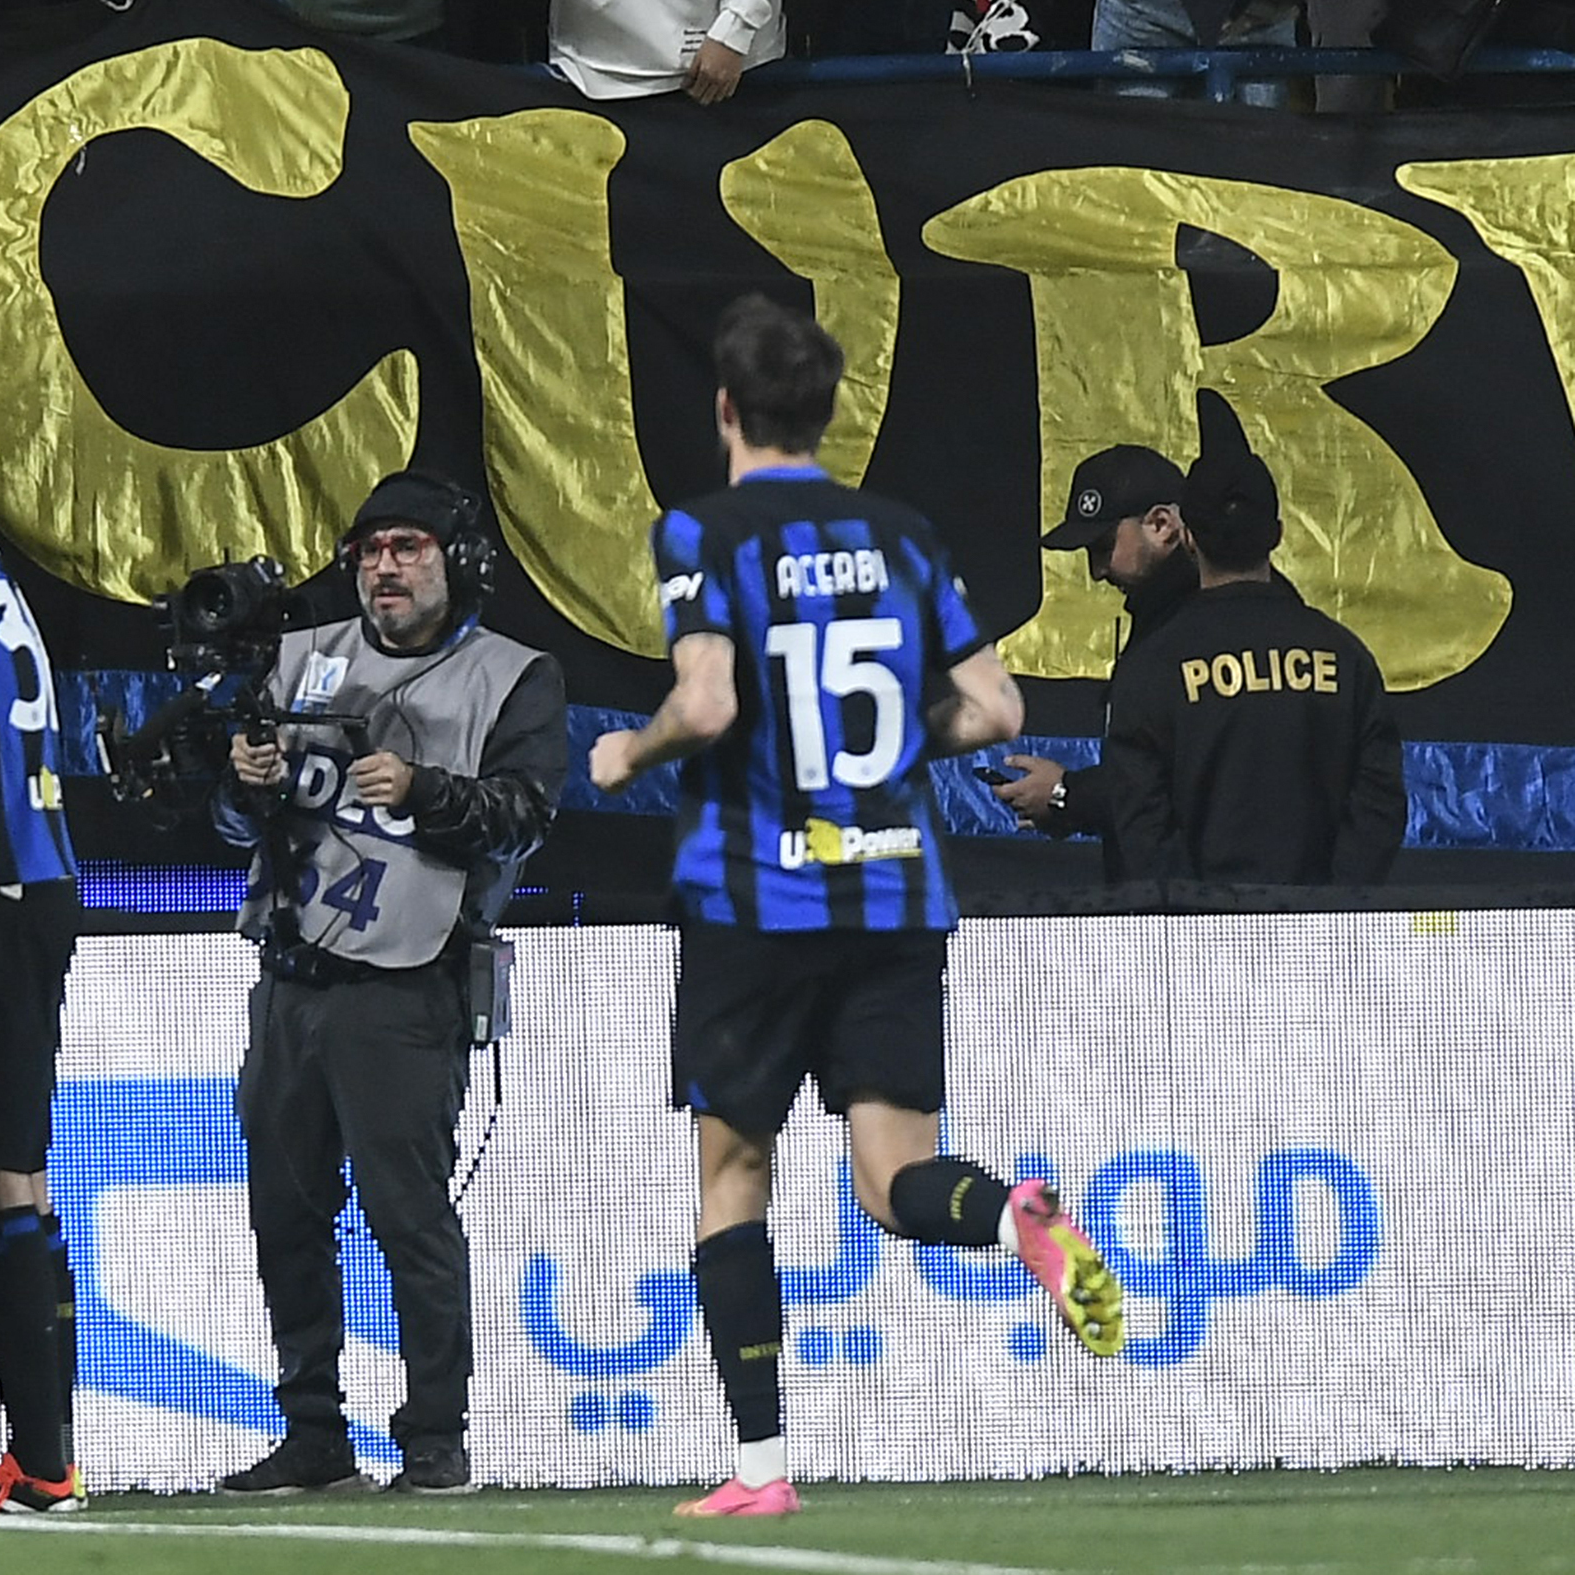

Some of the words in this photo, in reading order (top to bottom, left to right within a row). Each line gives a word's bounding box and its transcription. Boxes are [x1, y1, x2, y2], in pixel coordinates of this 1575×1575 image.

[777, 549, 889, 600] ACERBI
[765, 618, 904, 792] 15
[1180, 647, 1339, 707] POLICE
